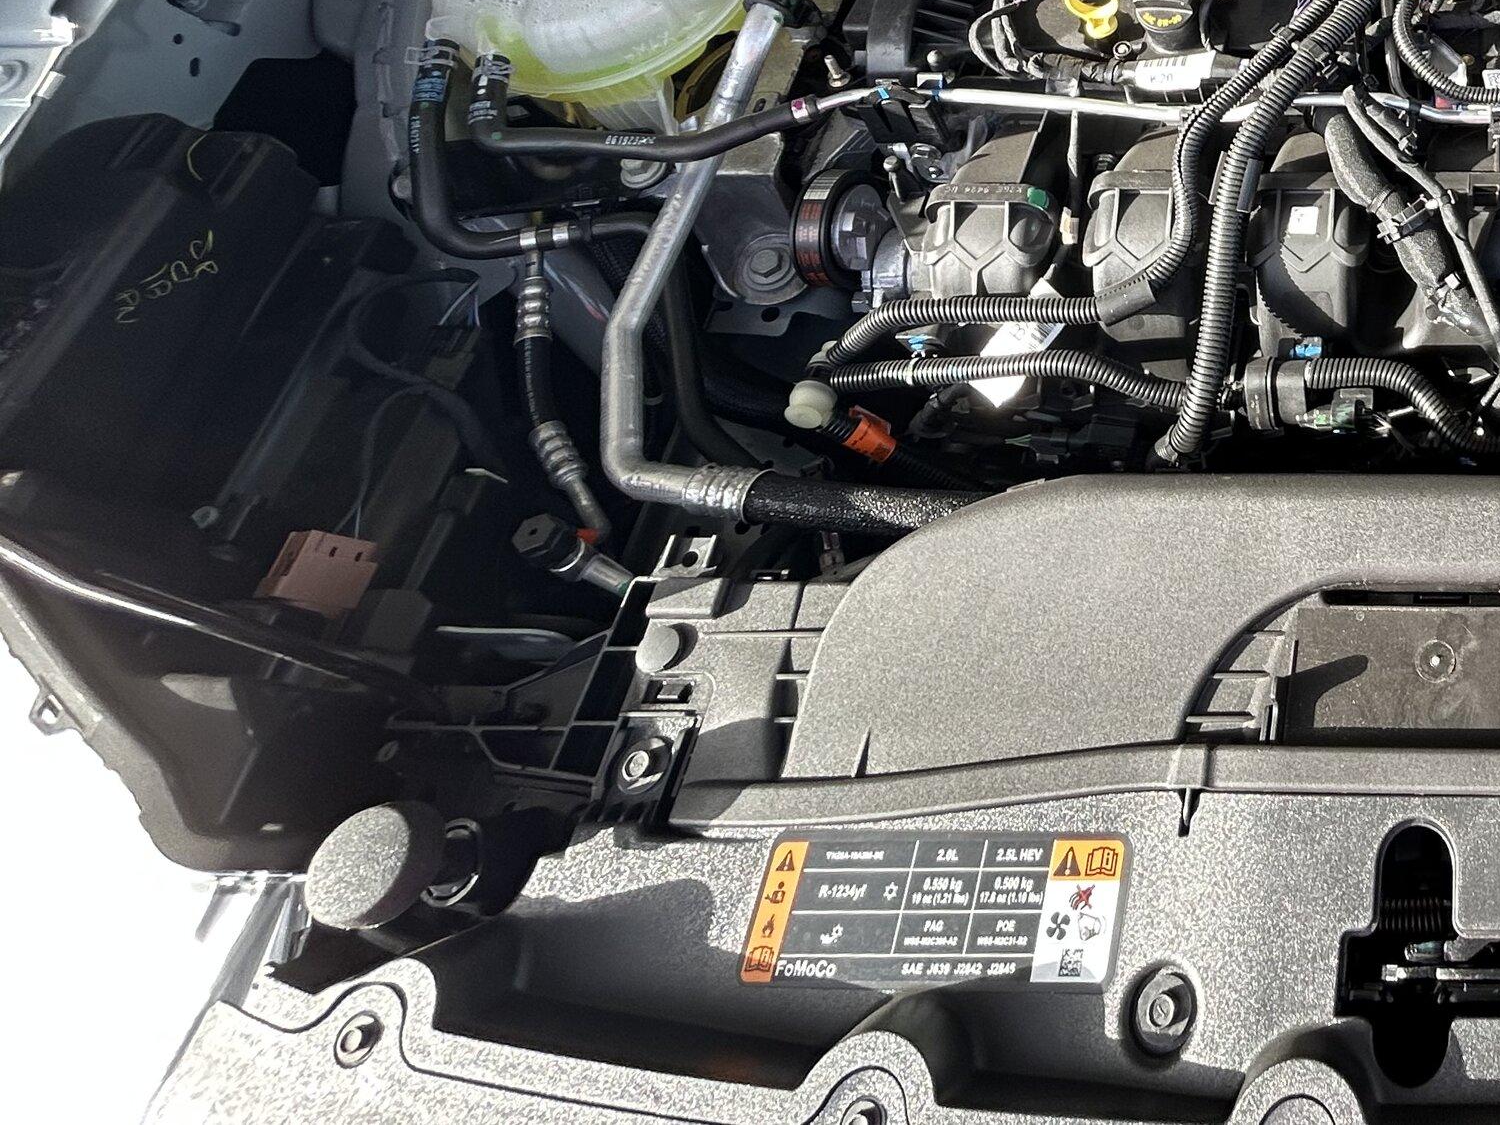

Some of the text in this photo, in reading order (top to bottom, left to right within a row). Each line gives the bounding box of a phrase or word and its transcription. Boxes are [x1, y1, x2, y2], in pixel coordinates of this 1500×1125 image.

[936, 848, 959, 862] 2.0L
[996, 847, 1044, 862] 2.5L HEV
[949, 876, 963, 893] kg
[1020, 876, 1034, 893] kg
[817, 883, 868, 902] R-1234yf
[923, 918, 945, 933] PAG
[995, 918, 1017, 932] POE
[774, 958, 838, 979] FoMoCo
[901, 962, 924, 975] SAE
